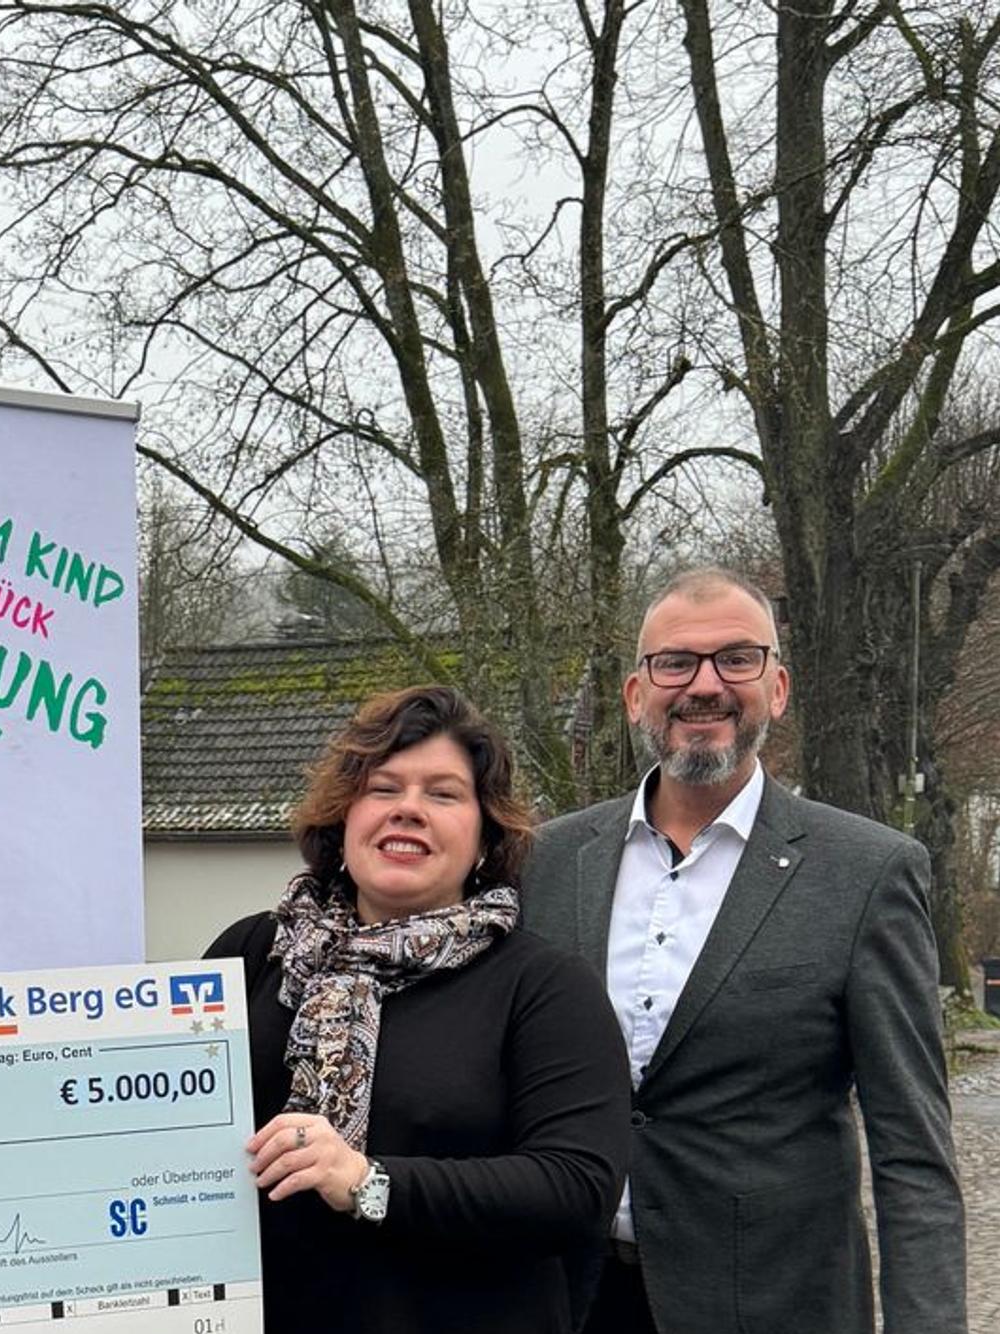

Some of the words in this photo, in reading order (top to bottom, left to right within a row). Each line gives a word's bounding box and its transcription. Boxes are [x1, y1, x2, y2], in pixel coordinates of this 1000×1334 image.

[25, 531, 125, 608] KIND
[27, 985, 104, 1019] Berg
[115, 979, 159, 1009] eG
[23, 1048, 58, 1063] Euro,
[61, 1046, 93, 1060] Cent
[88, 1068, 216, 1104] 5.000,00
[131, 1173, 160, 1187] oder
[162, 1168, 235, 1184] Überbringer
[153, 1193, 188, 1206] Schmidt
[109, 1198, 147, 1237] SC
[10, 1258, 27, 1267] des
[28, 1252, 78, 1264] Ausstellers
[76, 1283, 104, 1295] Scheck
[134, 1278, 153, 1288] nicht
[193, 1289, 211, 1300] Text
